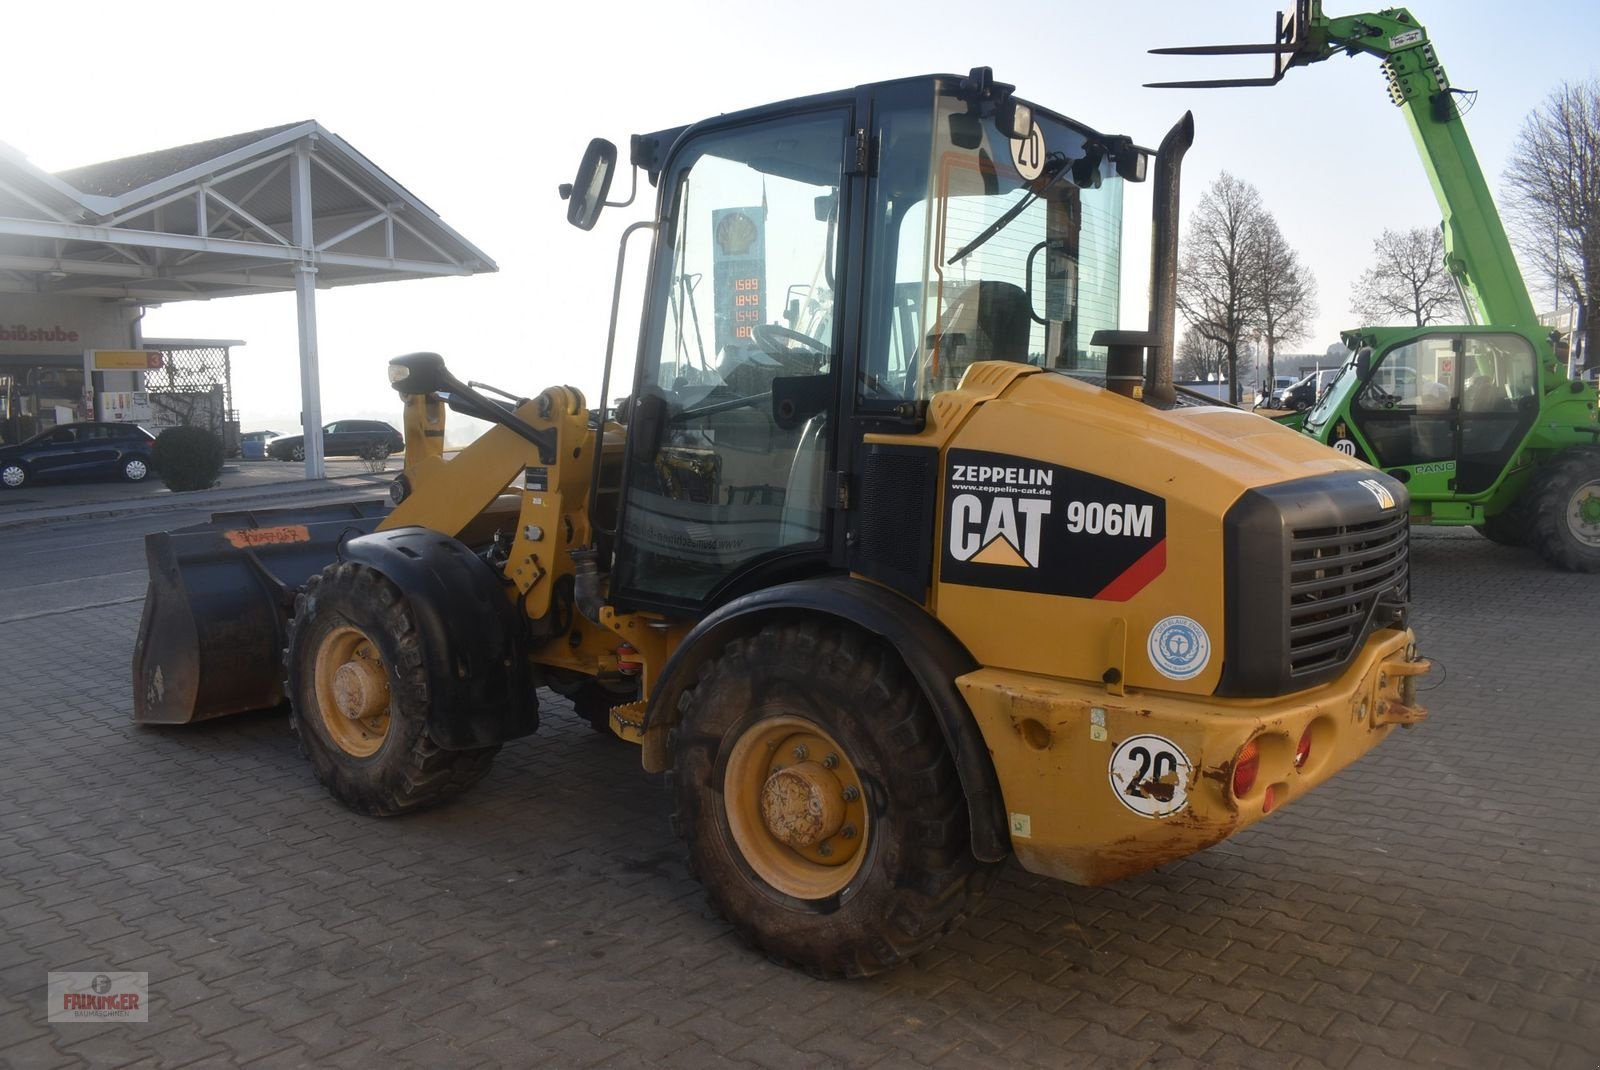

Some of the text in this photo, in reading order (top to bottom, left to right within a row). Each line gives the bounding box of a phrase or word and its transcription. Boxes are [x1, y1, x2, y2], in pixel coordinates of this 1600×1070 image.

[736, 278, 758, 290] 1589
[736, 294, 759, 306] 1849
[151, 354, 160, 367] 3
[952, 465, 1053, 486] ZEPPELIN
[951, 483, 1051, 495] www.zeppelin-cat.de
[1066, 501, 1153, 538] 906M
[950, 494, 1051, 568] CAT
[1126, 746, 1178, 803] 20
